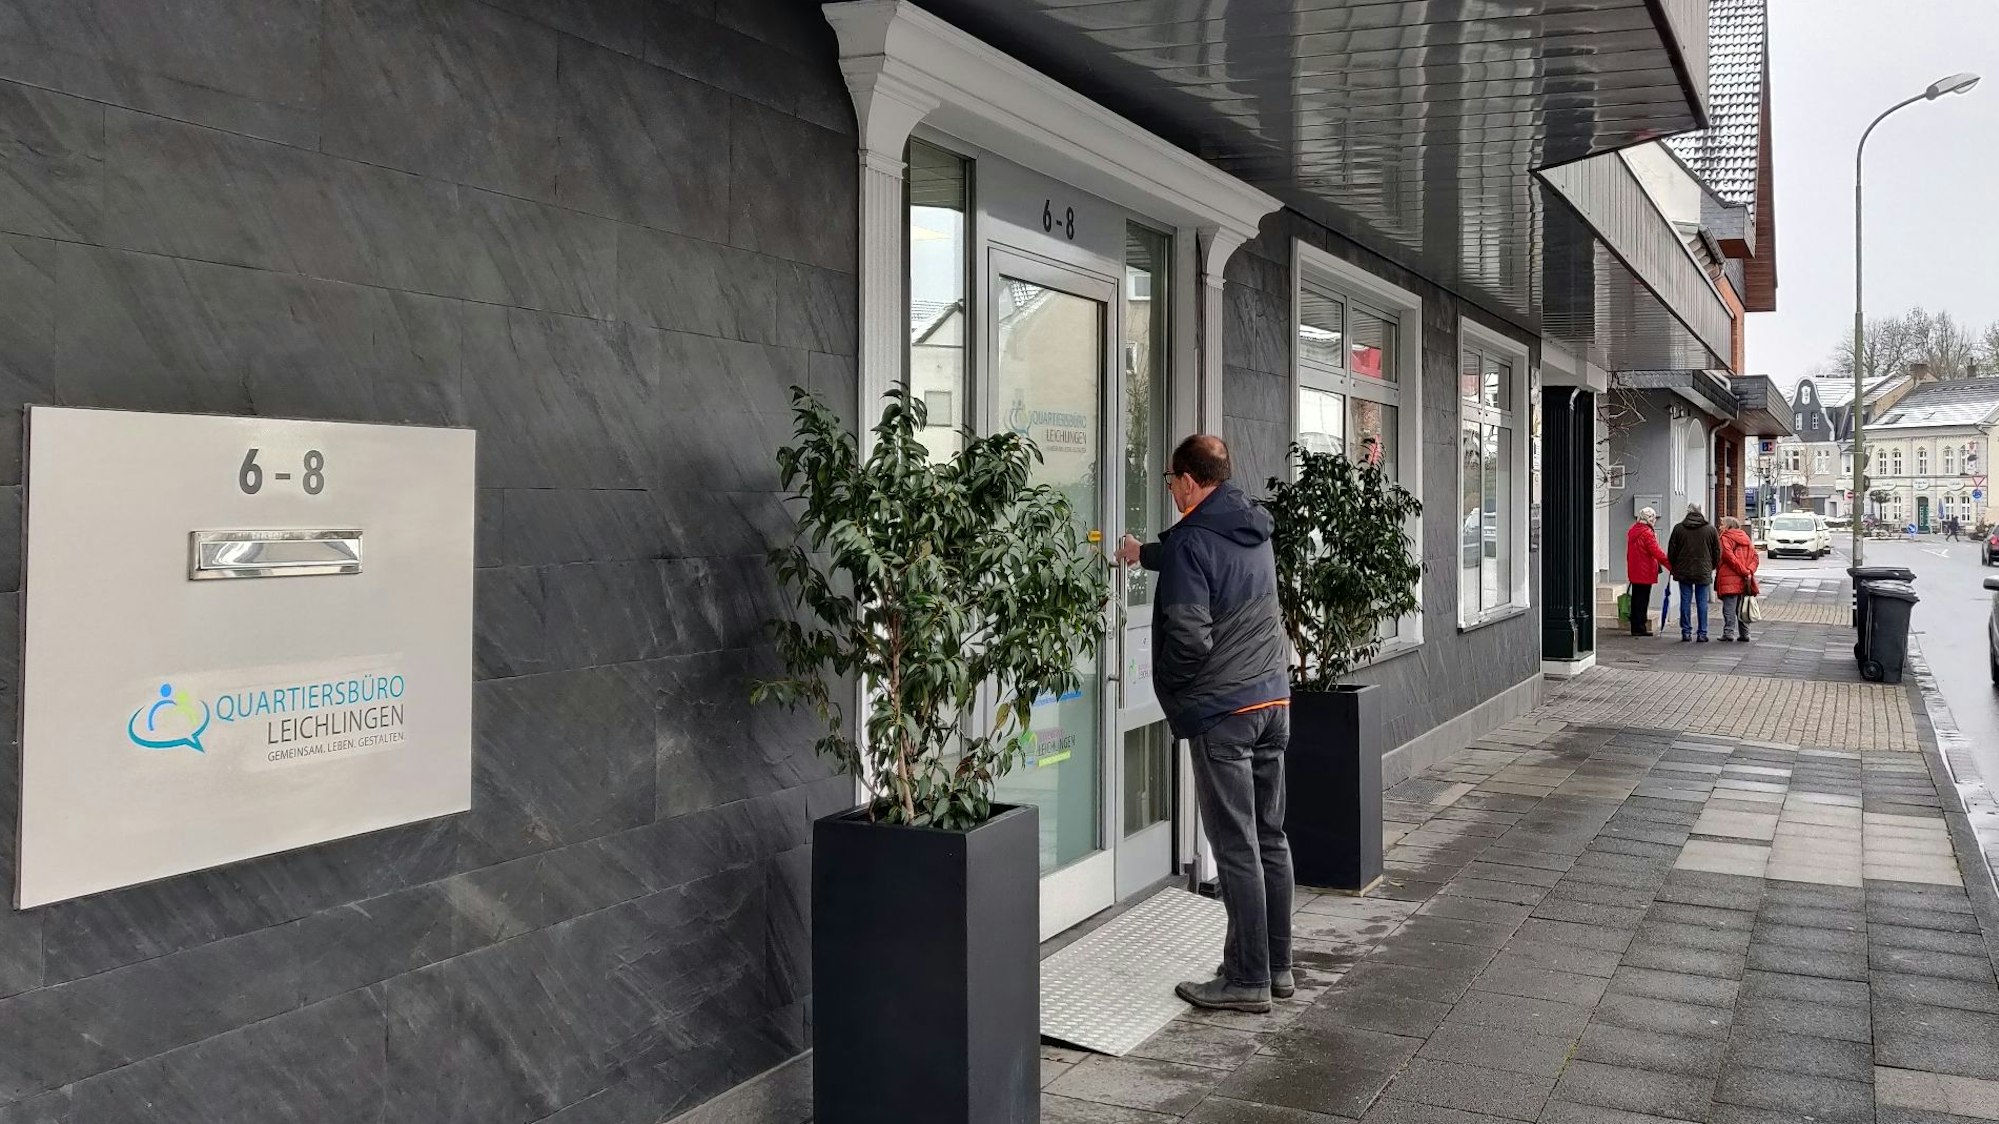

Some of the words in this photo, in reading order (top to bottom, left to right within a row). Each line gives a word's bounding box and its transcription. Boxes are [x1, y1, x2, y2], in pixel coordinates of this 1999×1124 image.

[216, 674, 405, 722] QUARTIERSBÜRO
[267, 703, 405, 745] LEICHLINGEN
[267, 743, 326, 762] GEMEINSAM.
[327, 739, 356, 753] LEBEN.
